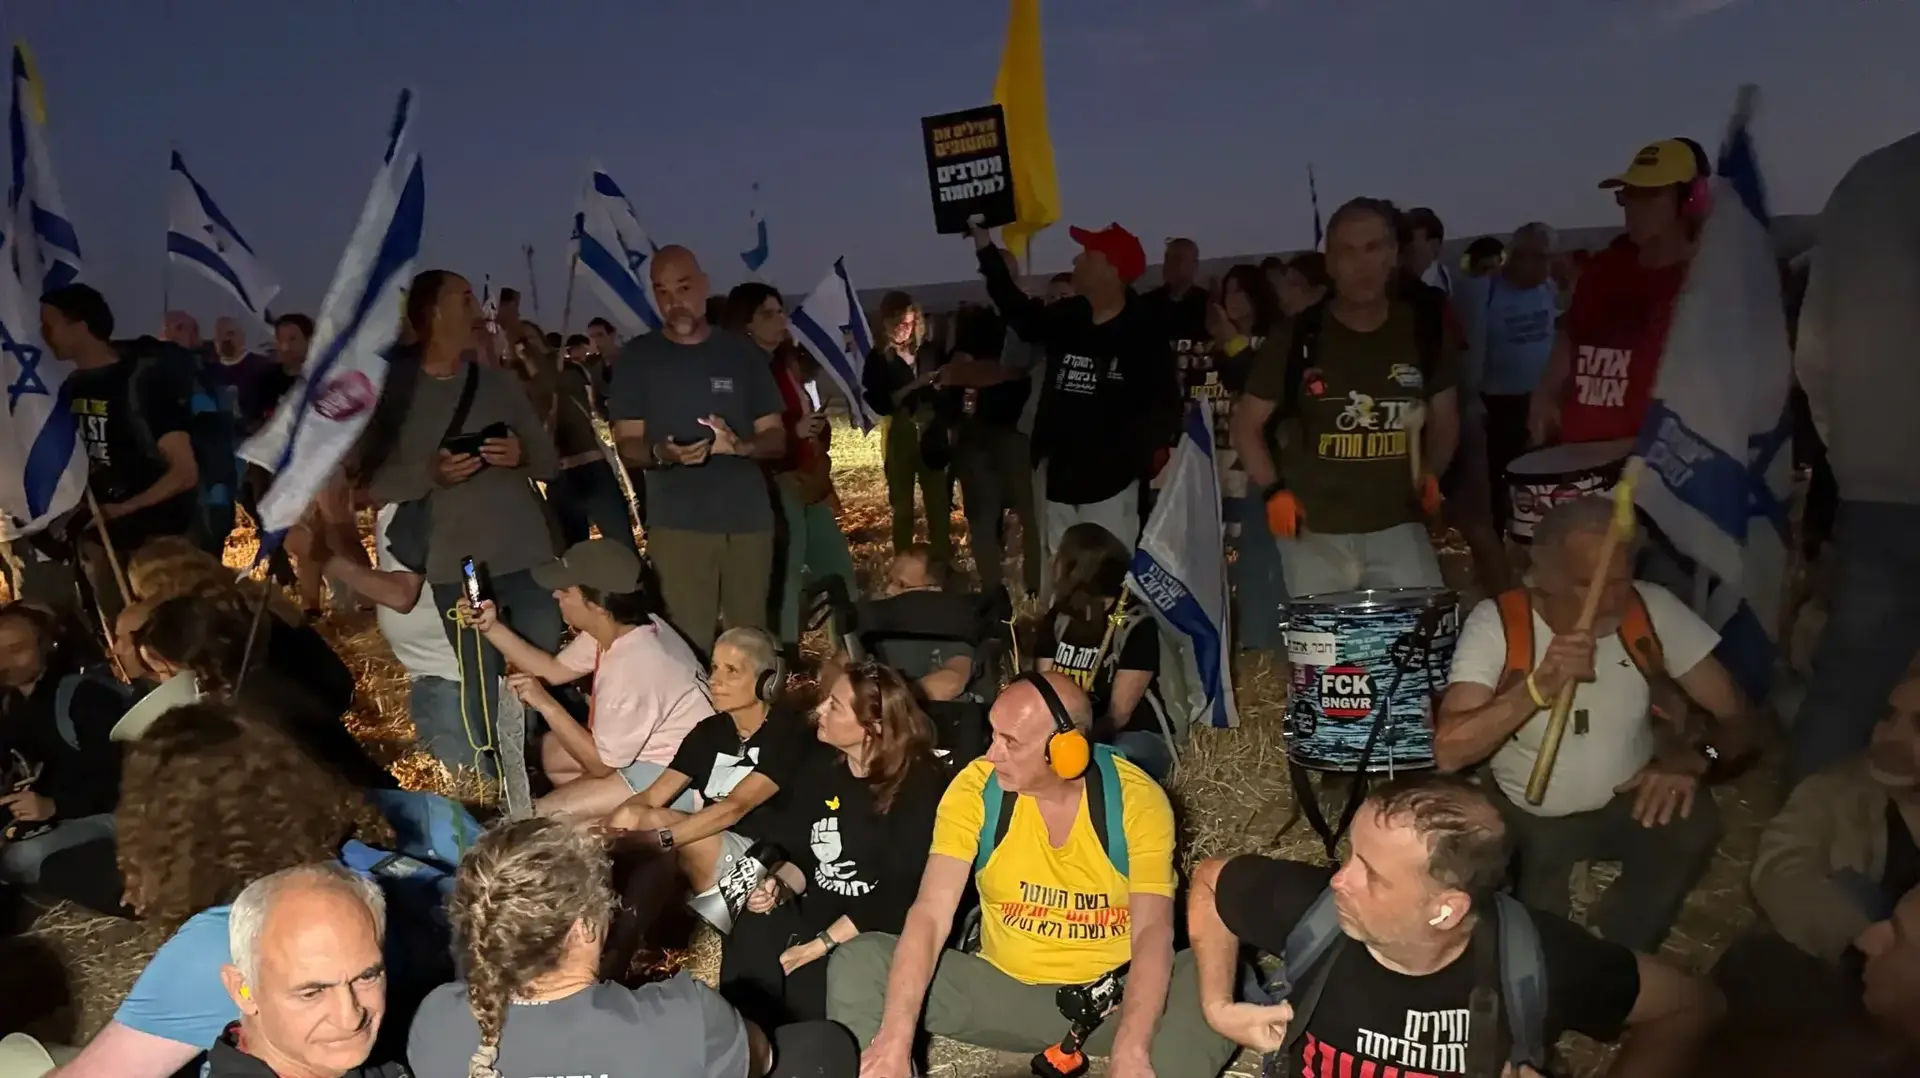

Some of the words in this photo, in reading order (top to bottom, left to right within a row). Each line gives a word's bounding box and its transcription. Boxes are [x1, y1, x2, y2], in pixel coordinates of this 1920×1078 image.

[937, 155, 1003, 183] מסרבים
[939, 174, 1005, 202] למלחמה
[1577, 345, 1632, 377] אתה
[1055, 641, 1075, 666] הם
[1322, 675, 1372, 695] FCK
[1321, 697, 1372, 709] BNGVR
[1020, 881, 1068, 909] העוטף
[1074, 893, 1110, 910] בשם
[1037, 920, 1062, 939] ולא
[1069, 922, 1106, 939] נשכח
[1404, 1009, 1470, 1043] חזירים
[1356, 1028, 1427, 1069] הביתה
[1431, 1043, 1468, 1074] תם
